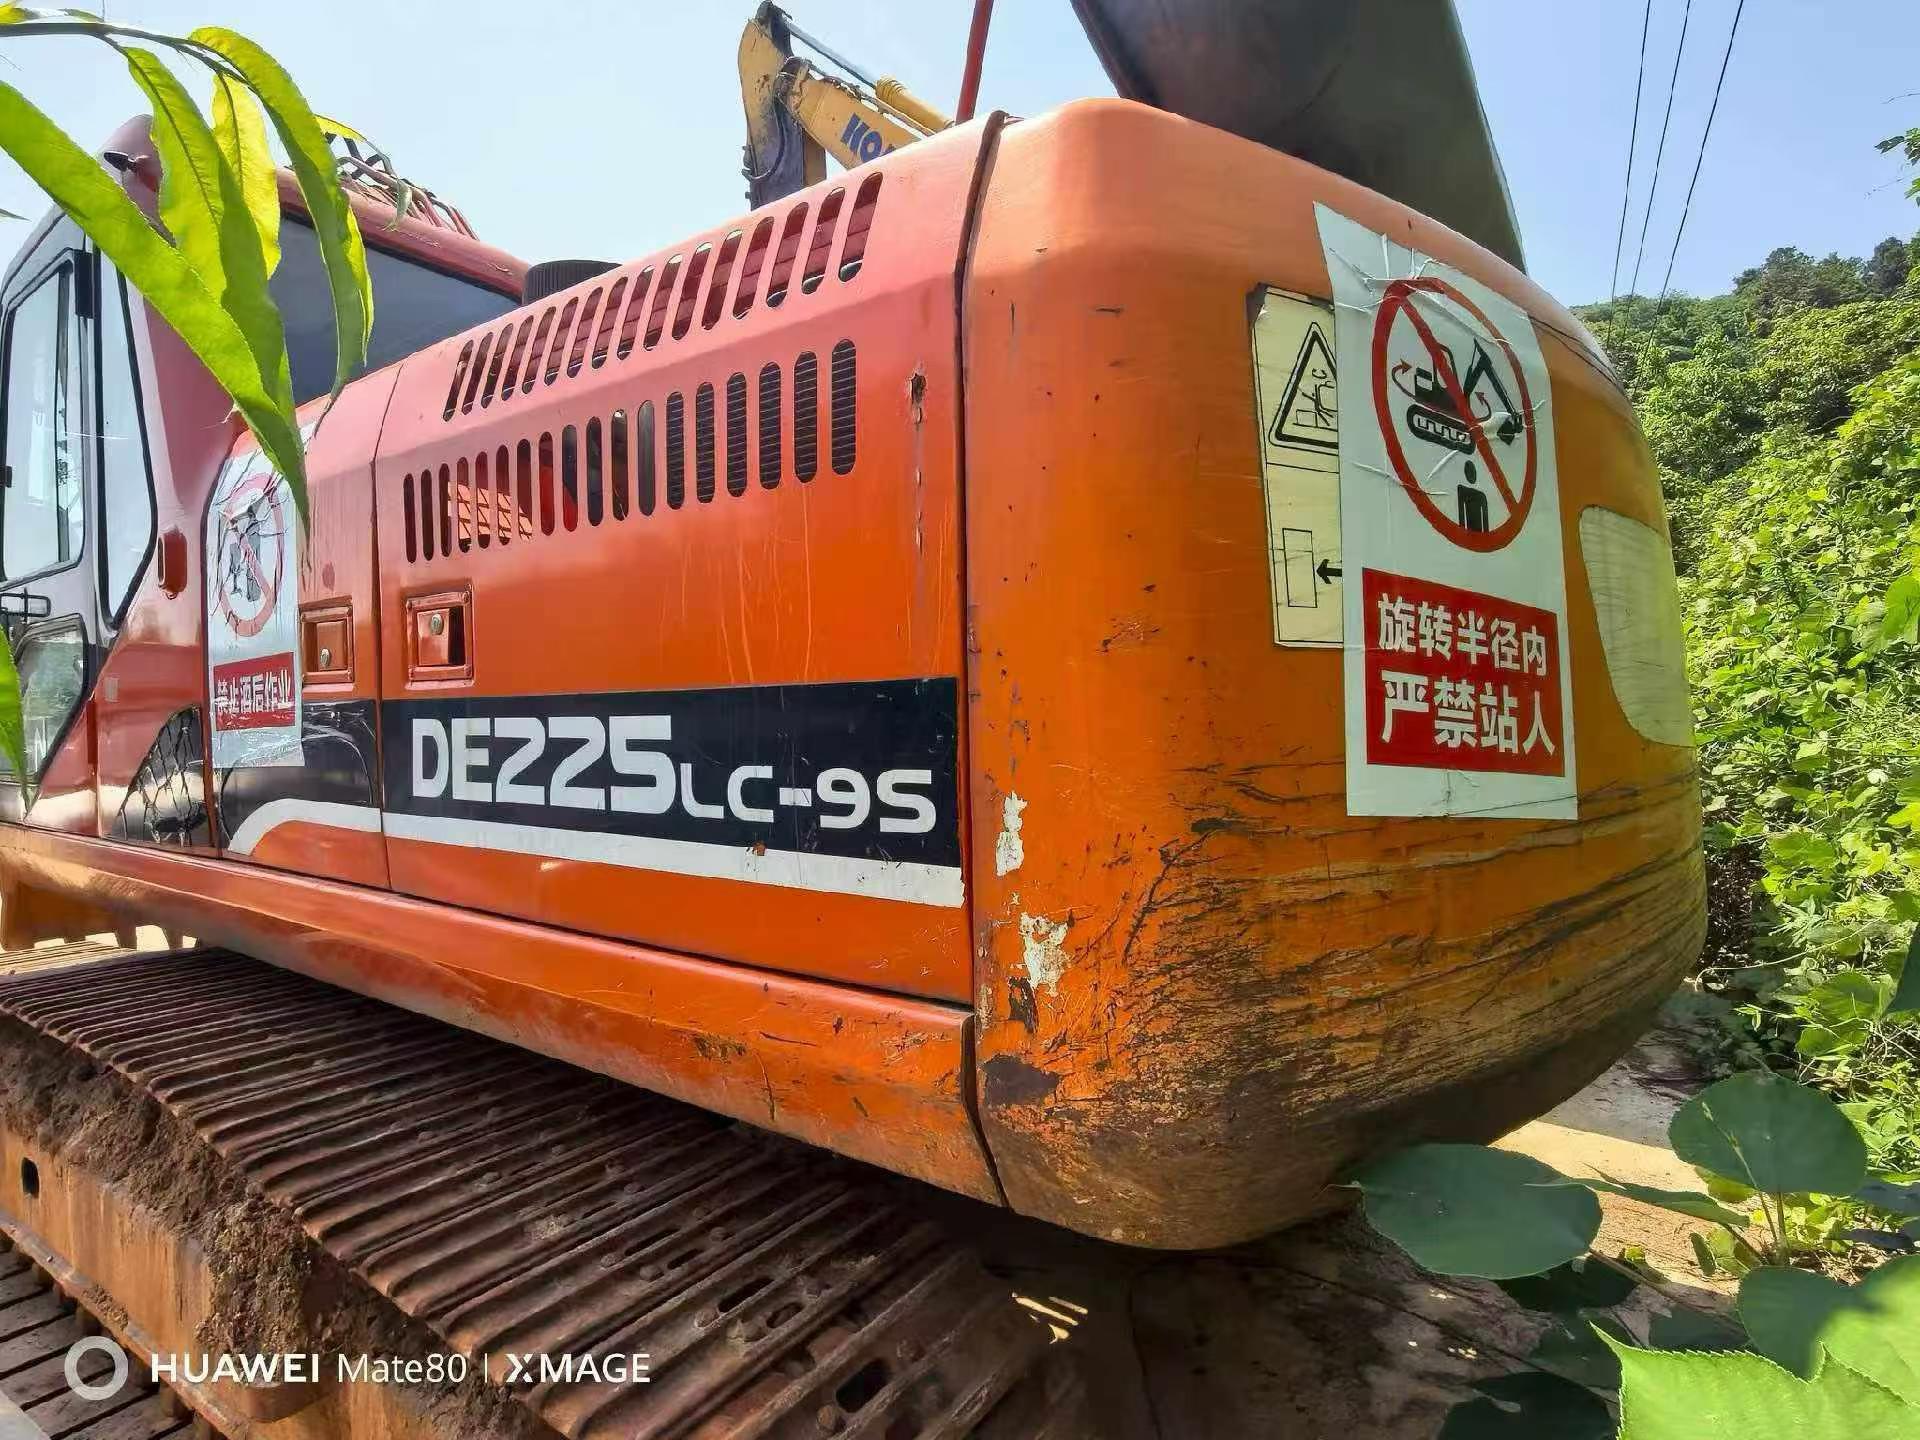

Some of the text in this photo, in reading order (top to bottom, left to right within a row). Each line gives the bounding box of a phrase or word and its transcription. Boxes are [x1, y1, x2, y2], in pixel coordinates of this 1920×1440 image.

[1378, 593, 1547, 676] 旋转半径内
[214, 669, 292, 714] 禁止酒后作业
[1381, 670, 1555, 756] 严禁站人
